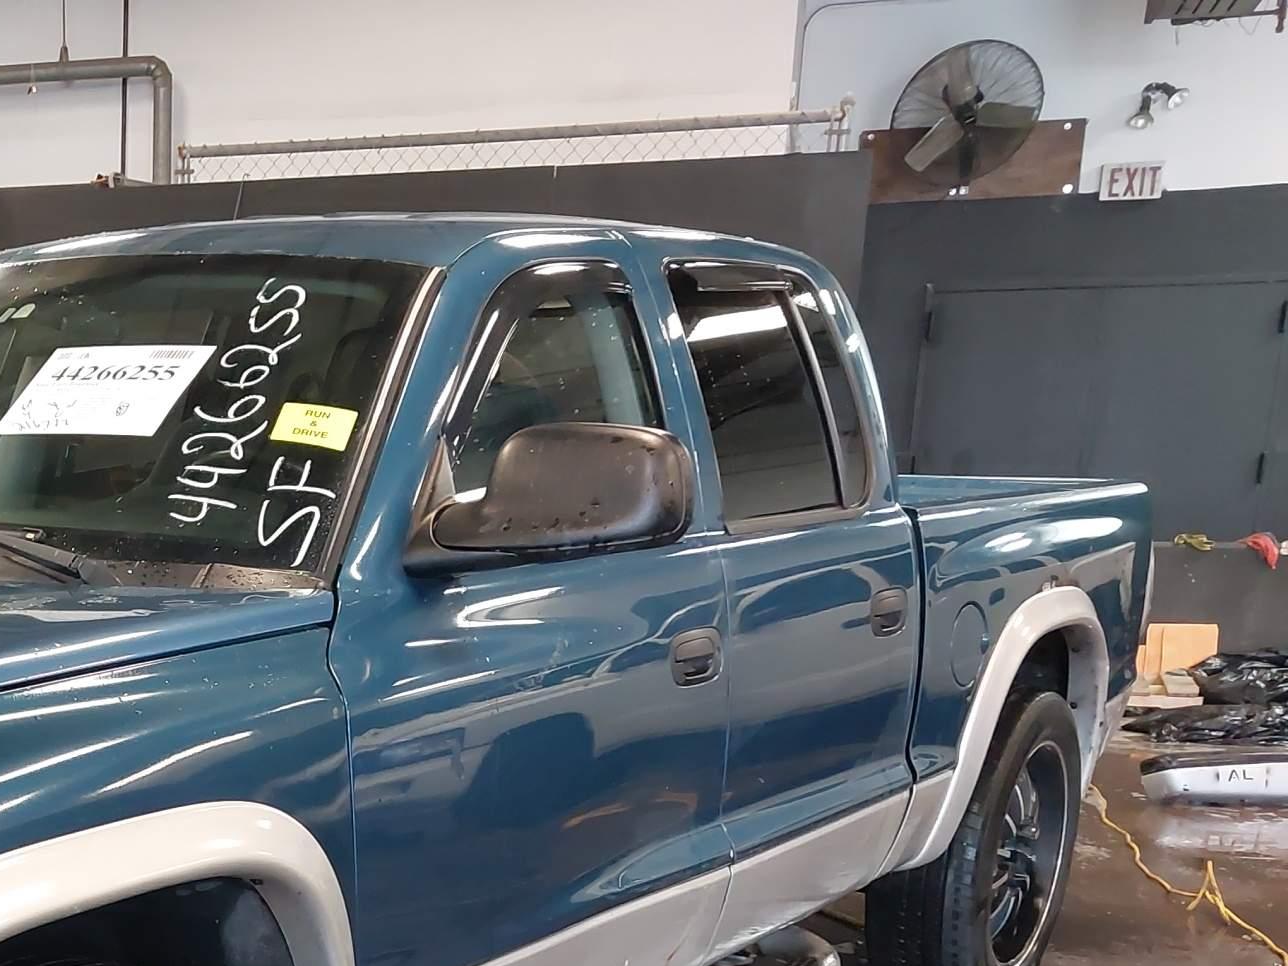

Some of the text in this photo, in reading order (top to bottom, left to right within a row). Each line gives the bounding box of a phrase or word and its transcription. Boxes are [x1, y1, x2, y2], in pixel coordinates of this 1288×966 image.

[1108, 166, 1161, 197] EXIT
[51, 365, 181, 381] 44266255
[168, 277, 306, 522] 44266255
[305, 409, 331, 419] RUN
[292, 427, 328, 439] DRIVE
[257, 456, 337, 567] SF
